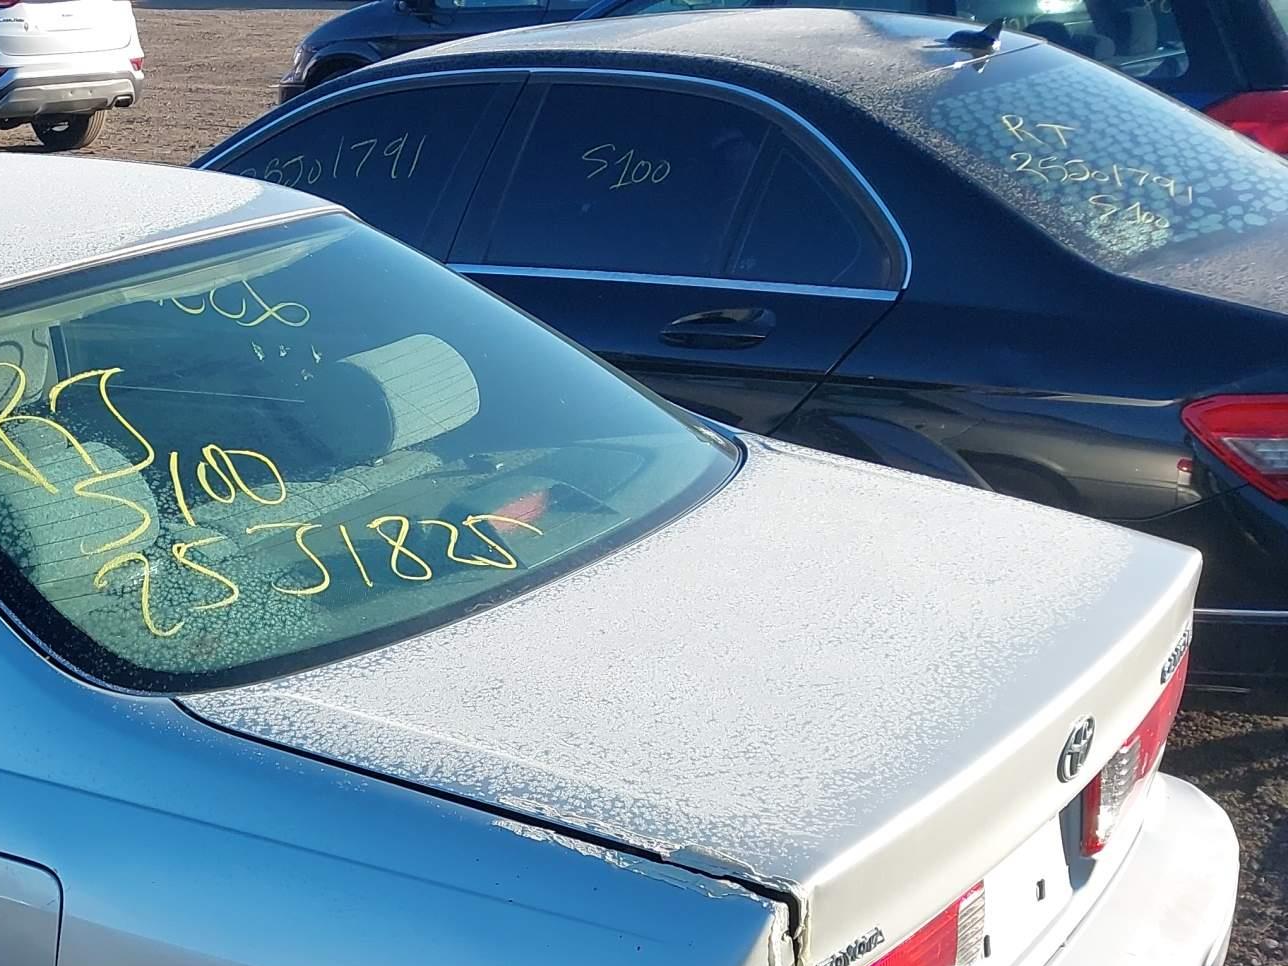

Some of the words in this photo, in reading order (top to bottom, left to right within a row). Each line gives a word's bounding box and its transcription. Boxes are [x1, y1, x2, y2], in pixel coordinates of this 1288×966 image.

[1002, 114, 1077, 148] RT
[582, 143, 671, 190] S100
[1088, 194, 1171, 229] S100
[73, 444, 287, 556] S100
